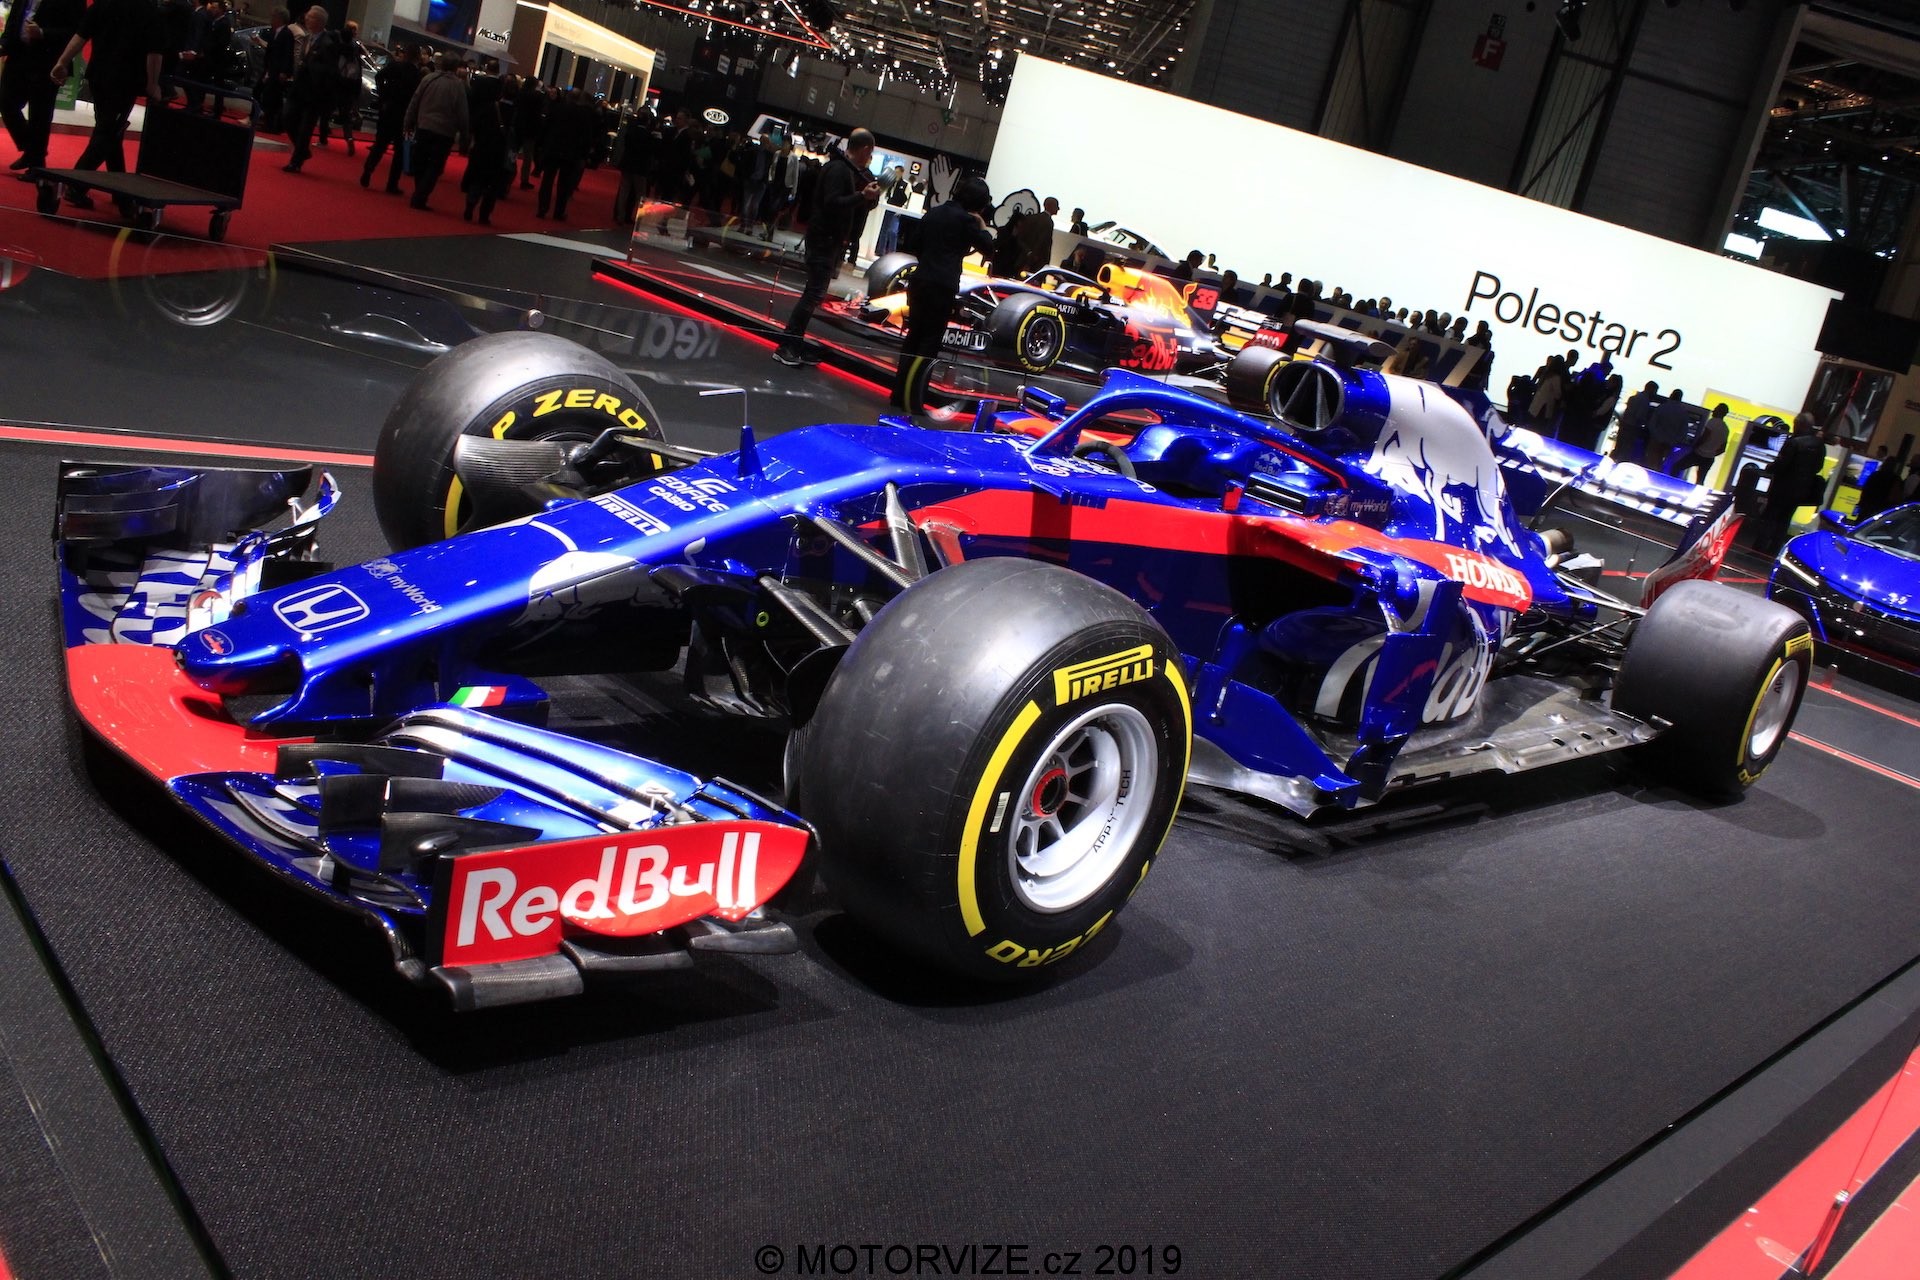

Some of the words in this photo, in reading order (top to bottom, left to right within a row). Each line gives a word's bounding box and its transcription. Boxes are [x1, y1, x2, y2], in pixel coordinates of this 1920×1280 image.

[1056, 303, 1080, 315] ARTIN
[1193, 287, 1219, 311] 33
[1464, 270, 1648, 358] Polestar
[1648, 329, 1682, 371] 2
[532, 389, 647, 431] ZERO
[587, 492, 672, 536] PIRELLI
[648, 486, 696, 512] CASIO
[655, 475, 730, 513] EDIFICE
[1444, 553, 1529, 600] HONDA
[1053, 643, 1154, 706] PIRELLI
[985, 909, 1114, 968] ZERO
